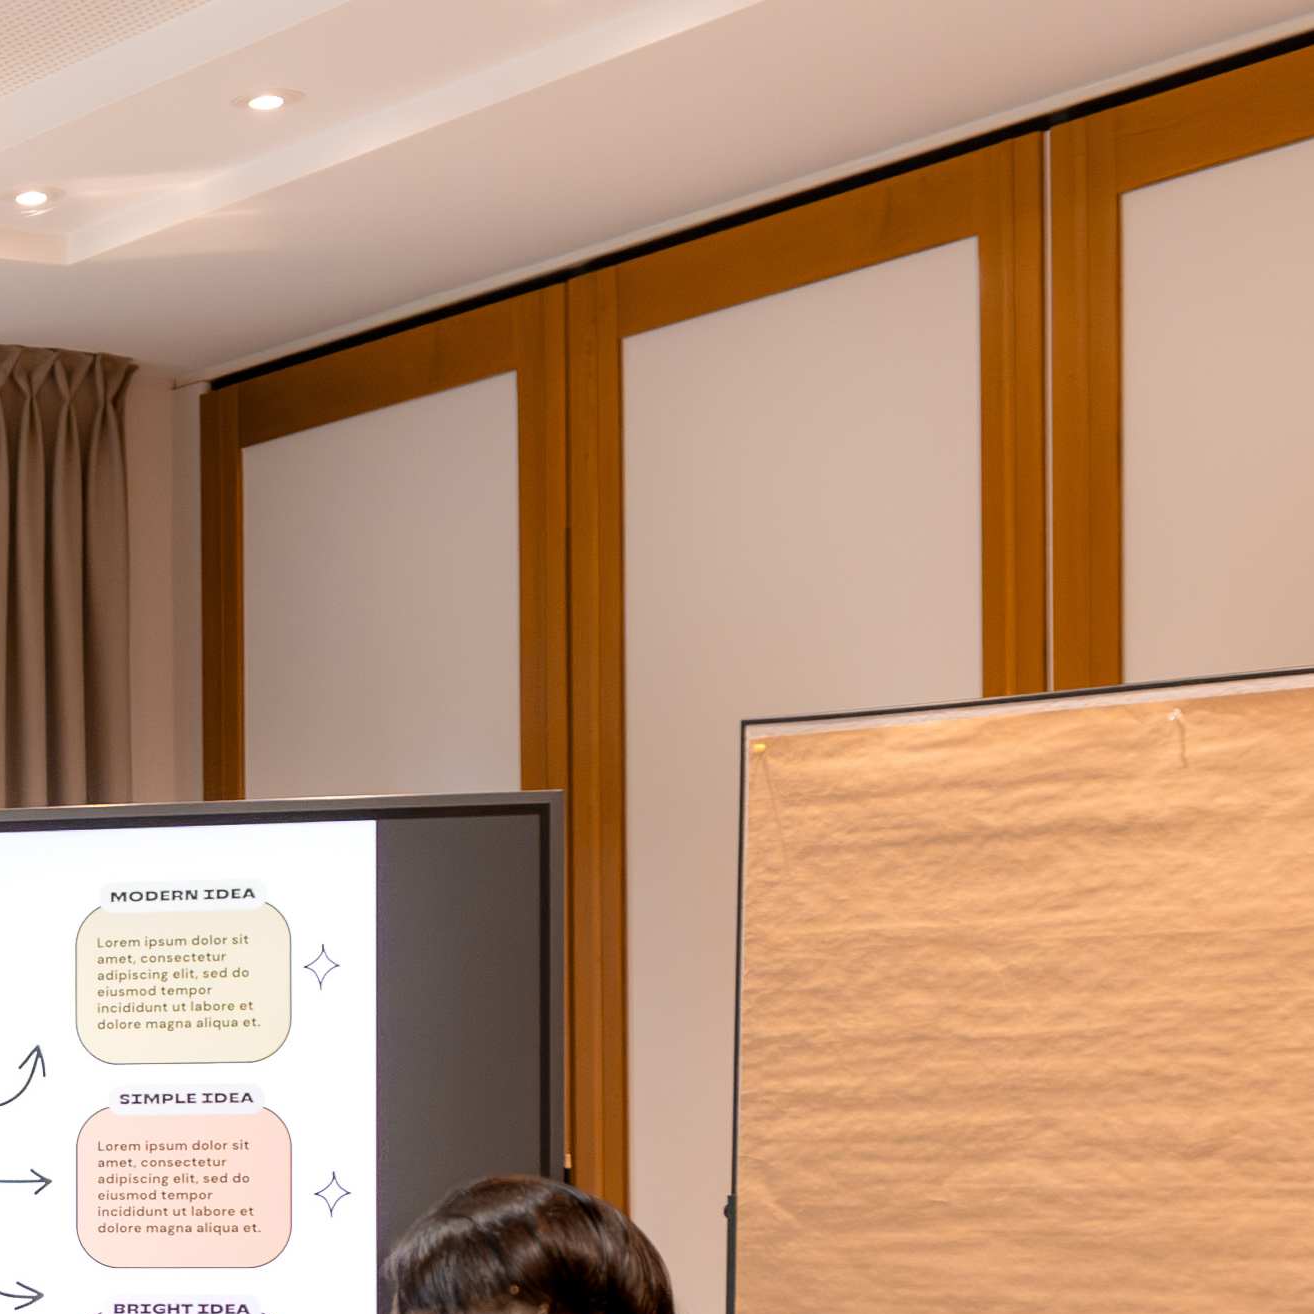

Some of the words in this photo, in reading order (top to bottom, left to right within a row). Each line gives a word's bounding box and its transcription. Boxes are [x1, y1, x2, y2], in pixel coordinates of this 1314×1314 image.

[110, 889, 199, 903] MODERN
[203, 887, 256, 900] IDEA
[96, 937, 141, 949] Lorem
[144, 935, 188, 950] ipsum
[191, 934, 228, 946] dolor
[231, 933, 249, 945] sit
[96, 954, 136, 965] amet,
[140, 952, 227, 964] consectetur
[96, 968, 169, 984] adipiscing
[172, 967, 199, 980] elit,
[202, 967, 228, 979] sed
[231, 967, 250, 979] do
[96, 985, 157, 998] eiusmod
[160, 986, 213, 999] tempor
[97, 1001, 168, 1014] incididunt
[172, 1002, 187, 1013] ut
[190, 1000, 236, 1013] labore
[239, 1000, 254, 1011] et
[97, 1018, 142, 1031] dolore
[145, 1020, 192, 1032] magna
[196, 1016, 239, 1031] aliqua
[242, 1017, 261, 1028] et.
[119, 1092, 197, 1105] SIMPLE
[201, 1092, 254, 1104] IDEA
[97, 1140, 141, 1152] Lorem
[145, 1140, 188, 1154] ipsum
[191, 1139, 229, 1152] dolor
[231, 1138, 250, 1151] sit
[97, 1158, 137, 1169] amet,
[140, 1157, 227, 1168] consectetur
[97, 1173, 169, 1187] adipiscing
[172, 1172, 199, 1185] elit,
[202, 1172, 228, 1184] sed
[232, 1172, 250, 1184] do
[97, 1189, 157, 1201] eiusmod
[160, 1191, 214, 1203] tempor
[97, 1205, 169, 1217] incididunt
[172, 1207, 188, 1217] ut
[190, 1205, 236, 1217] labore
[239, 1207, 254, 1217] et
[97, 1222, 142, 1234] dolore
[145, 1224, 193, 1237] magna
[196, 1221, 239, 1236] aliqua
[242, 1223, 262, 1233] et.
[113, 1303, 194, 1314] BRIGHT
[197, 1303, 251, 1314] IDEA
